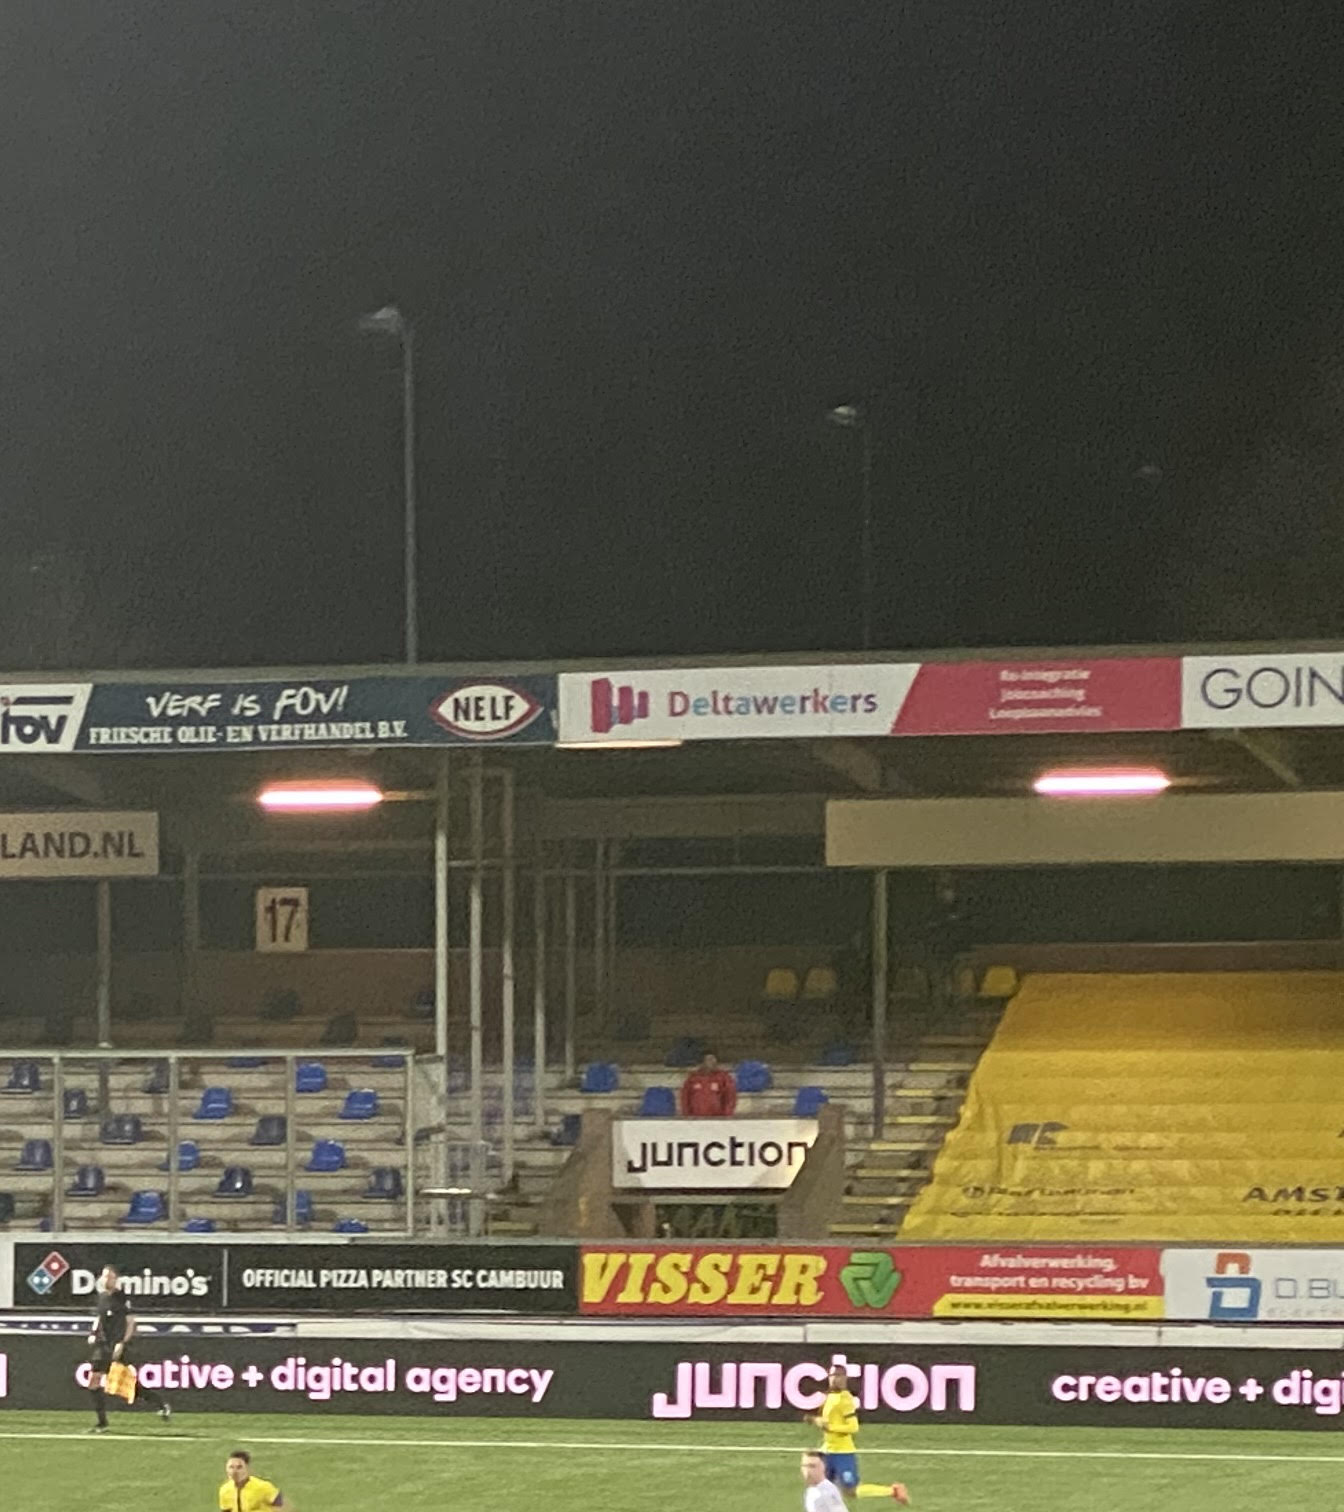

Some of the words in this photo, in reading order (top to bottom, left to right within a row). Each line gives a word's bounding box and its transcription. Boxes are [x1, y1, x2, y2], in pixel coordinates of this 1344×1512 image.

[231, 693, 262, 716] IS
[453, 696, 515, 722] NELF
[668, 688, 878, 717] Deltawerkers
[89, 726, 173, 744] FRIESCHE
[226, 724, 253, 742] EN
[263, 897, 301, 944] 17
[242, 1268, 317, 1288] OFFICIAL
[320, 1268, 368, 1289] PIZZA
[372, 1268, 448, 1289] PARTNER
[450, 1269, 473, 1290] SC
[475, 1269, 564, 1290] CAMBUUR
[582, 1252, 829, 1305] VISSER
[949, 1274, 1025, 1291] transport
[1028, 1276, 1049, 1288] en
[1051, 1273, 1125, 1292] recycling
[1127, 1274, 1150, 1288] bv
[75, 1354, 234, 1390] cative
[270, 1357, 395, 1400] digital
[405, 1364, 554, 1403] agency
[1052, 1367, 1231, 1404] creative
[1272, 1369, 1344, 1415] dig
